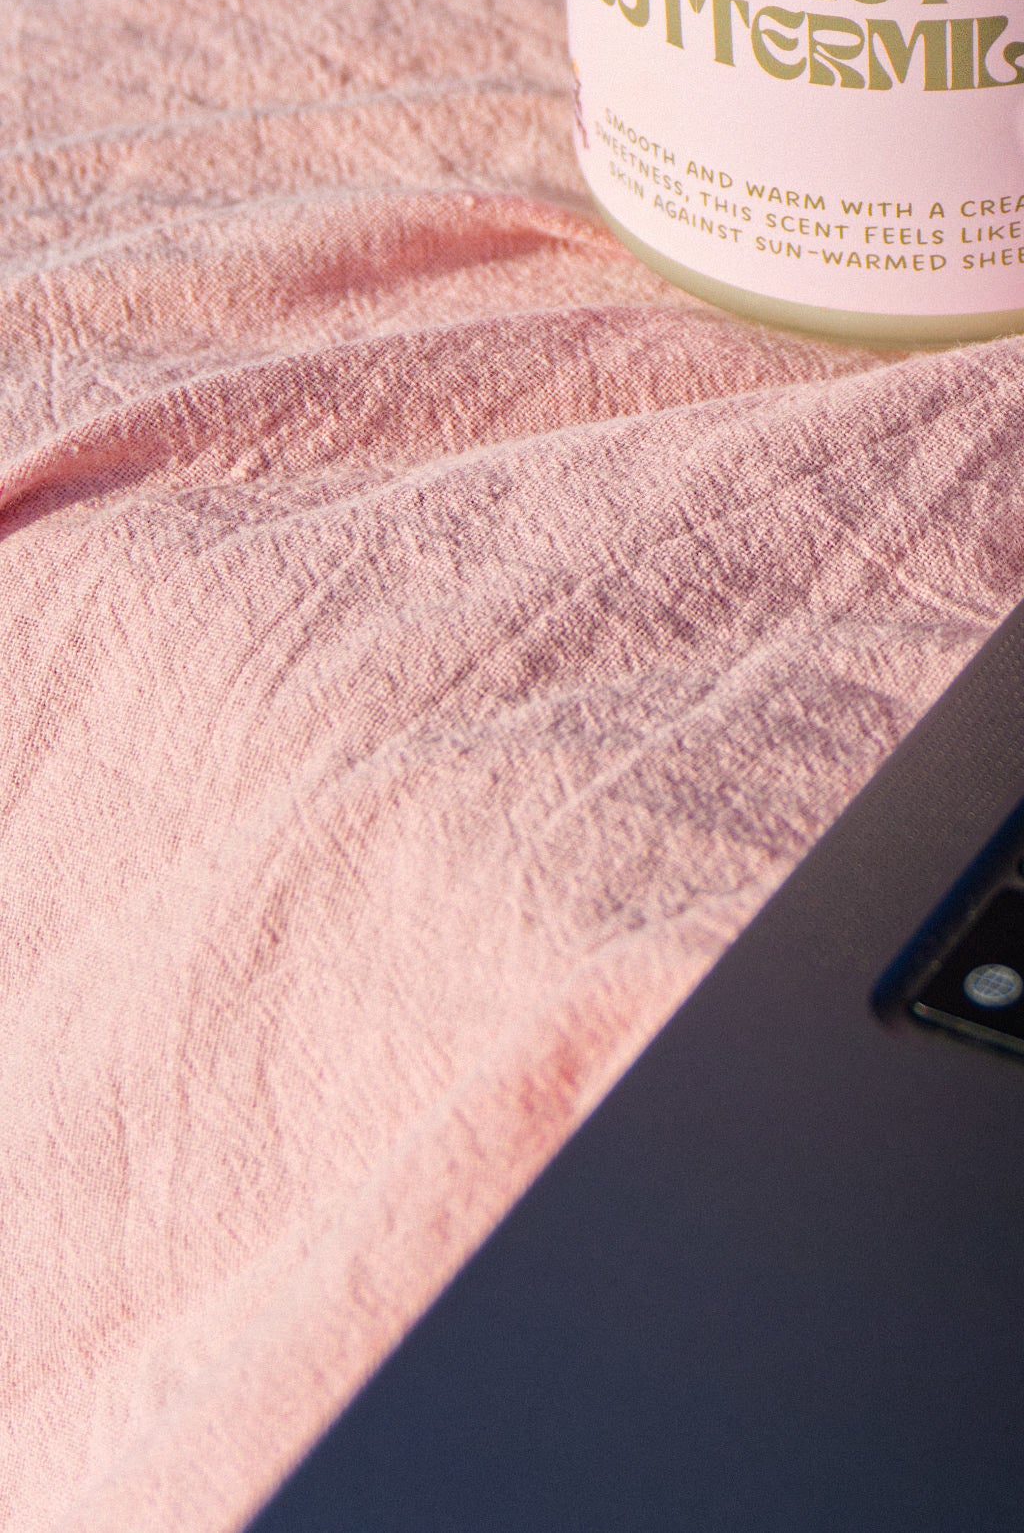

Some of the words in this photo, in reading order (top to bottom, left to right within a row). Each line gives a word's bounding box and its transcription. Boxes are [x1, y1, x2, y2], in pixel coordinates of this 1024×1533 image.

[595, 121, 690, 203] SWEETNESS,
[700, 191, 753, 222] THIS
[765, 213, 849, 240] SCENT
[864, 225, 944, 246] FEELS
[961, 220, 1022, 244] LIKE
[605, 107, 676, 166] SMOOTH
[686, 160, 733, 189] AND
[746, 180, 826, 211] WARM
[841, 198, 913, 217] WITH
[929, 202, 945, 219] A
[609, 160, 645, 200] SKIN
[653, 194, 743, 243] AGAINST
[755, 235, 947, 272] SUN-WARMED
